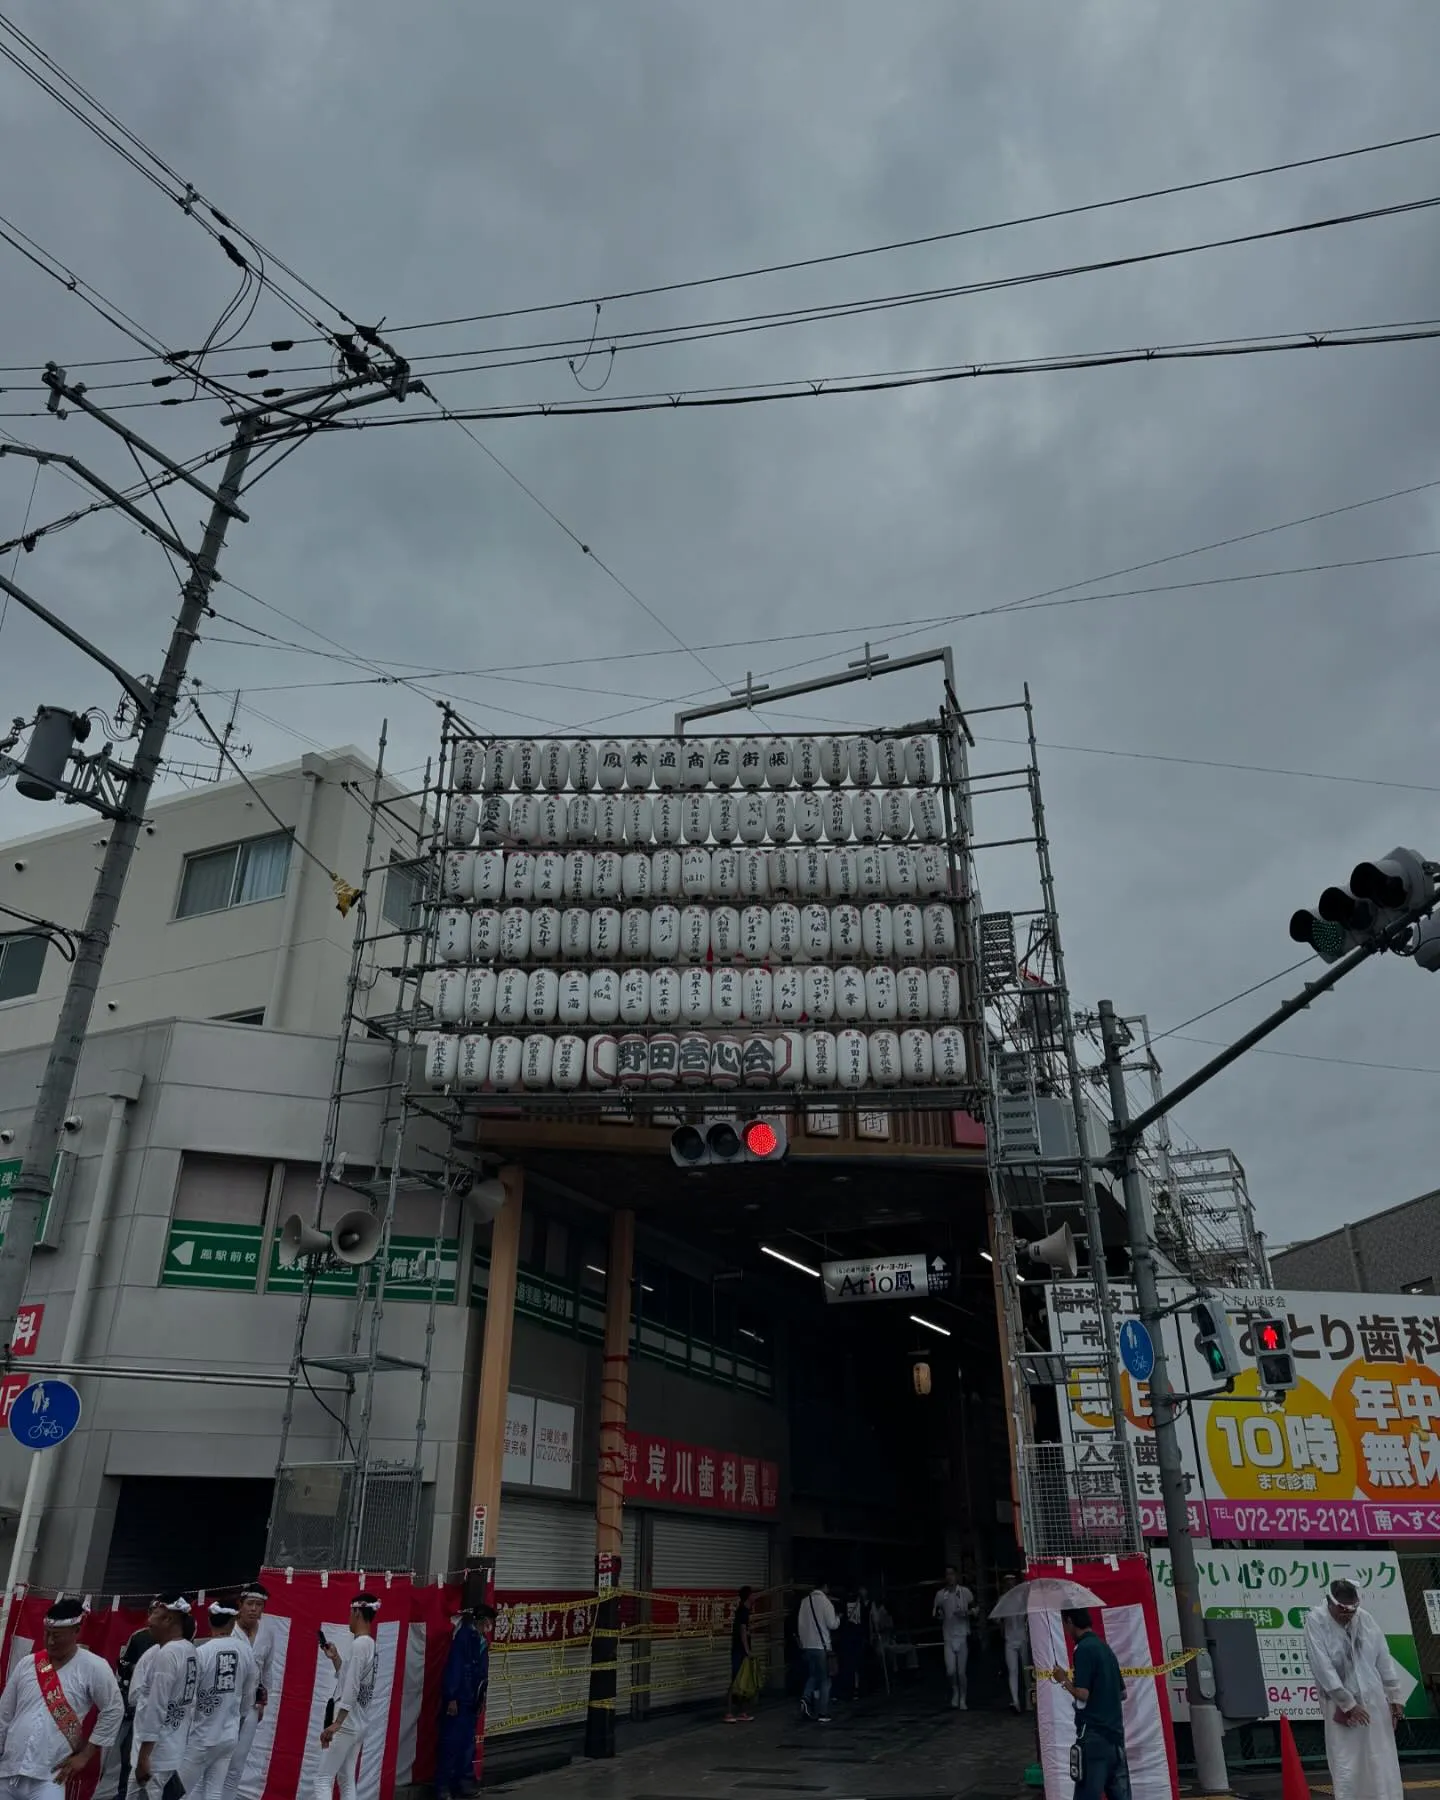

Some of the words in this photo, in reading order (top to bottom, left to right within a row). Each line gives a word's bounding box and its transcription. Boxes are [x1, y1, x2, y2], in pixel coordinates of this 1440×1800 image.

[1216, 1413, 1342, 1475] 10時
[1234, 1507, 1360, 1534] 072-275-2121
[1156, 1559, 1396, 1589] ない心のクリック
